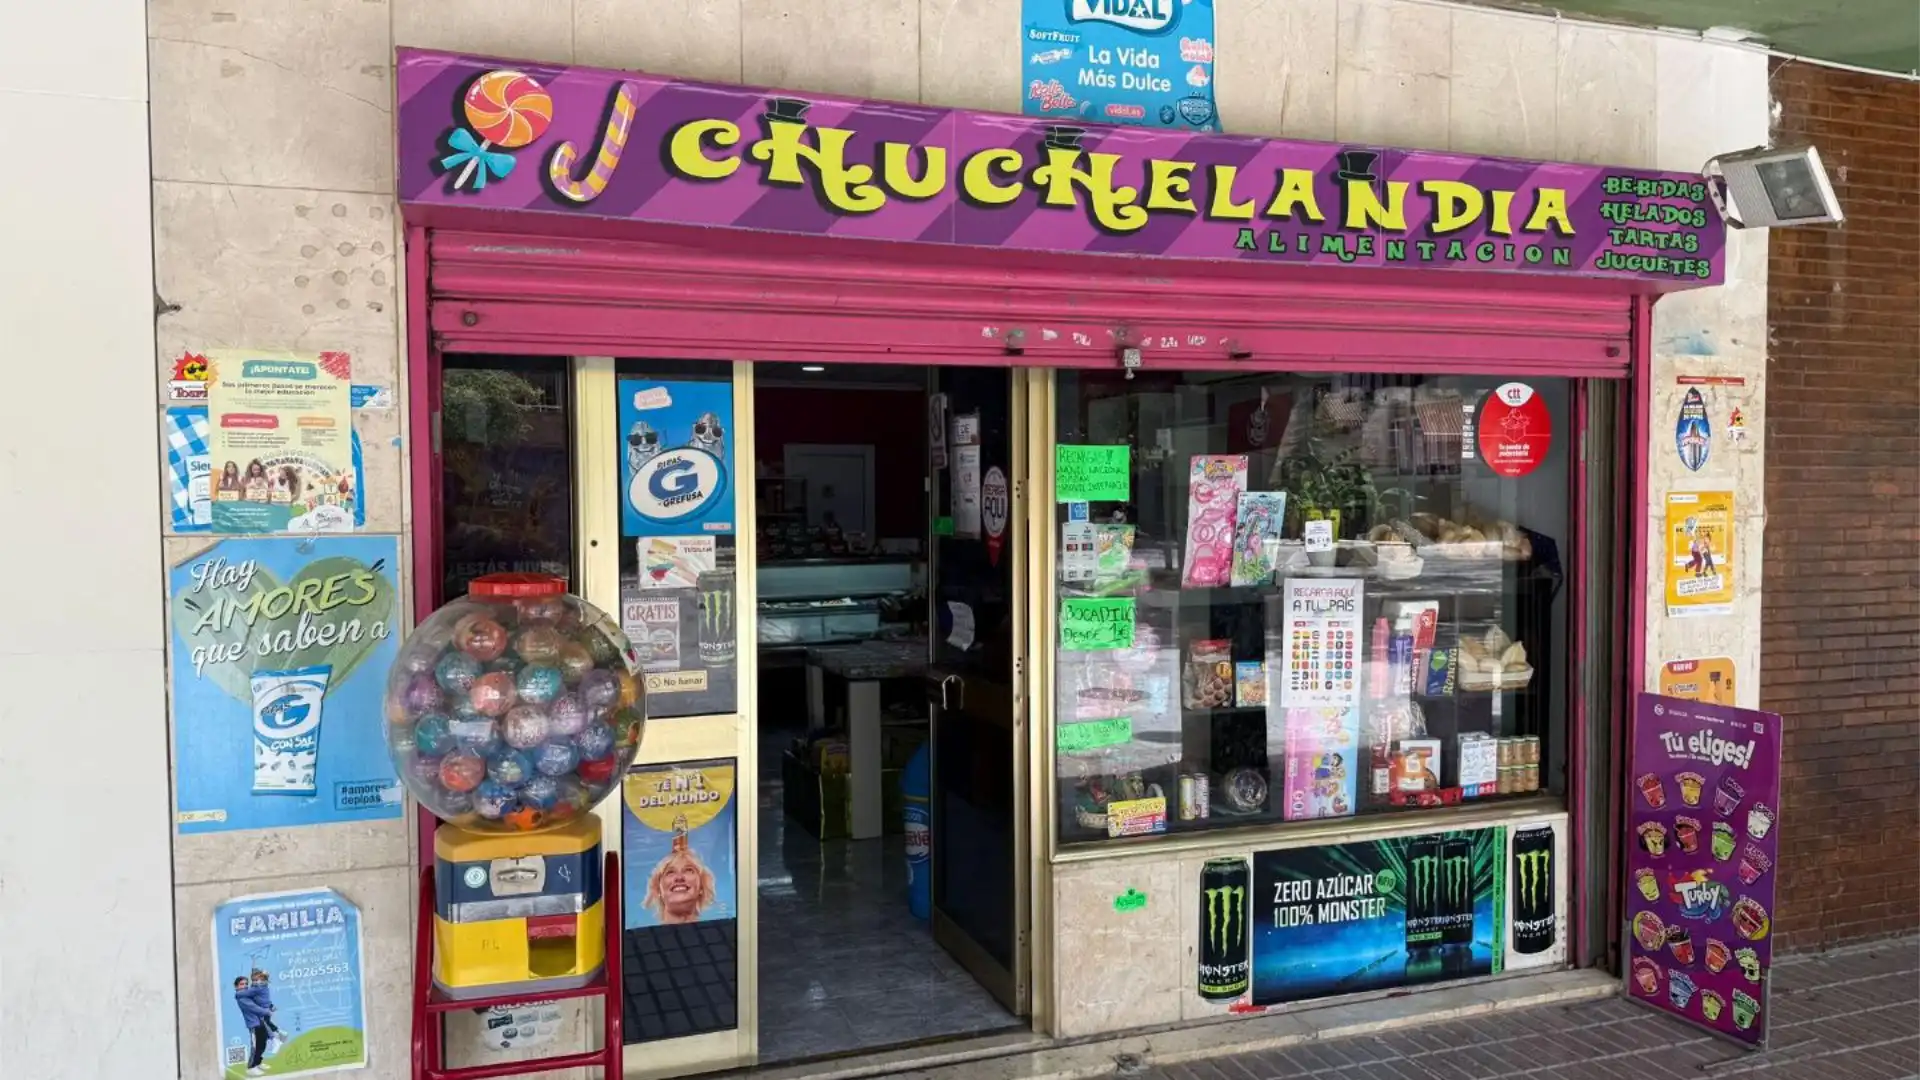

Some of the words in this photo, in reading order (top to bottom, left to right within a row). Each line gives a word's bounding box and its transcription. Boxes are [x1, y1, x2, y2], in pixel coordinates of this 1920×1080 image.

[1075, 0, 1167, 19] VIDAL
[1088, 45, 1110, 65] La
[1116, 46, 1160, 69] Vida
[1078, 67, 1117, 88] Más
[1122, 71, 1172, 92] Dulce
[669, 113, 1577, 236] CHUCHELANDIA
[1603, 176, 1706, 202] BEBIDAS
[1600, 202, 1707, 228] HELADOS
[1236, 228, 1572, 267] ALIMENTACION
[1609, 228, 1698, 252] TARTAS
[1595, 250, 1711, 279] JUGUETES
[657, 455, 682, 470] PIPAS
[648, 459, 699, 500] G
[662, 490, 704, 508] GREFUSA
[191, 557, 258, 594] Hay
[191, 569, 378, 636] AMORES
[627, 603, 676, 622] GRATIS
[1293, 601, 1302, 612] A
[191, 641, 248, 678] que
[258, 611, 364, 656] saben
[371, 622, 390, 640] a
[663, 677, 677, 687] No
[678, 676, 704, 687] fumar
[1659, 732, 1684, 753] Tú
[1688, 728, 1756, 770] eliges!
[640, 796, 665, 808] DEL
[669, 790, 720, 805] MUNDO
[1273, 879, 1312, 903] ZERO
[1316, 872, 1373, 899] AZÚCAR
[1674, 882, 1720, 910] Turby
[231, 905, 345, 936] FAMILIA
[1274, 904, 1313, 928] 100%
[1317, 897, 1385, 924] MONSTER
